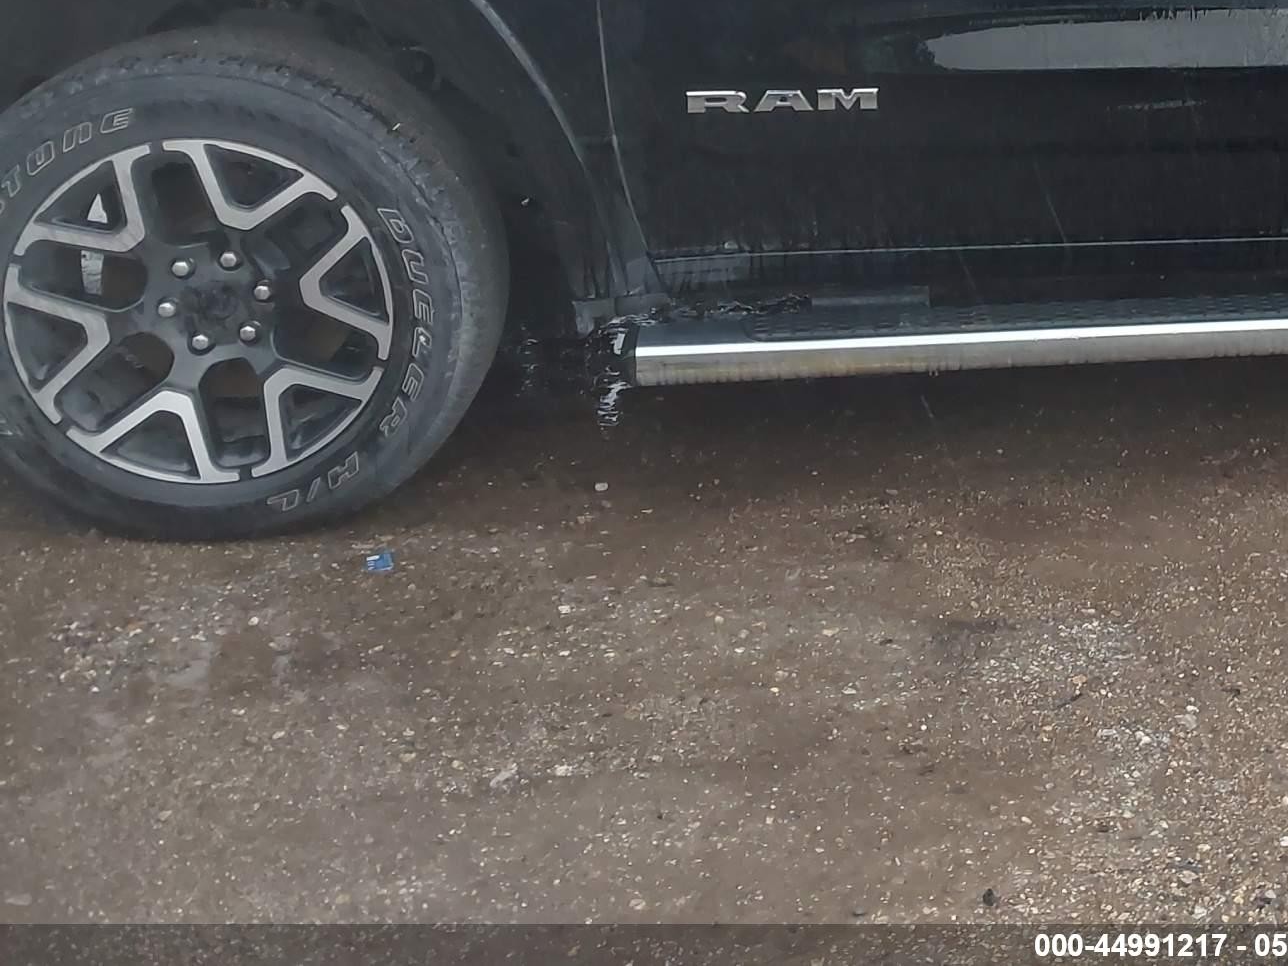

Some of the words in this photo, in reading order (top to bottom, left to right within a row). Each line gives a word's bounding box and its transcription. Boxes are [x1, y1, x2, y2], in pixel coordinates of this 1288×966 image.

[686, 87, 880, 114] RAM
[0, 107, 135, 216] TONE
[376, 206, 437, 437] DUELER
[265, 450, 361, 513] H/L
